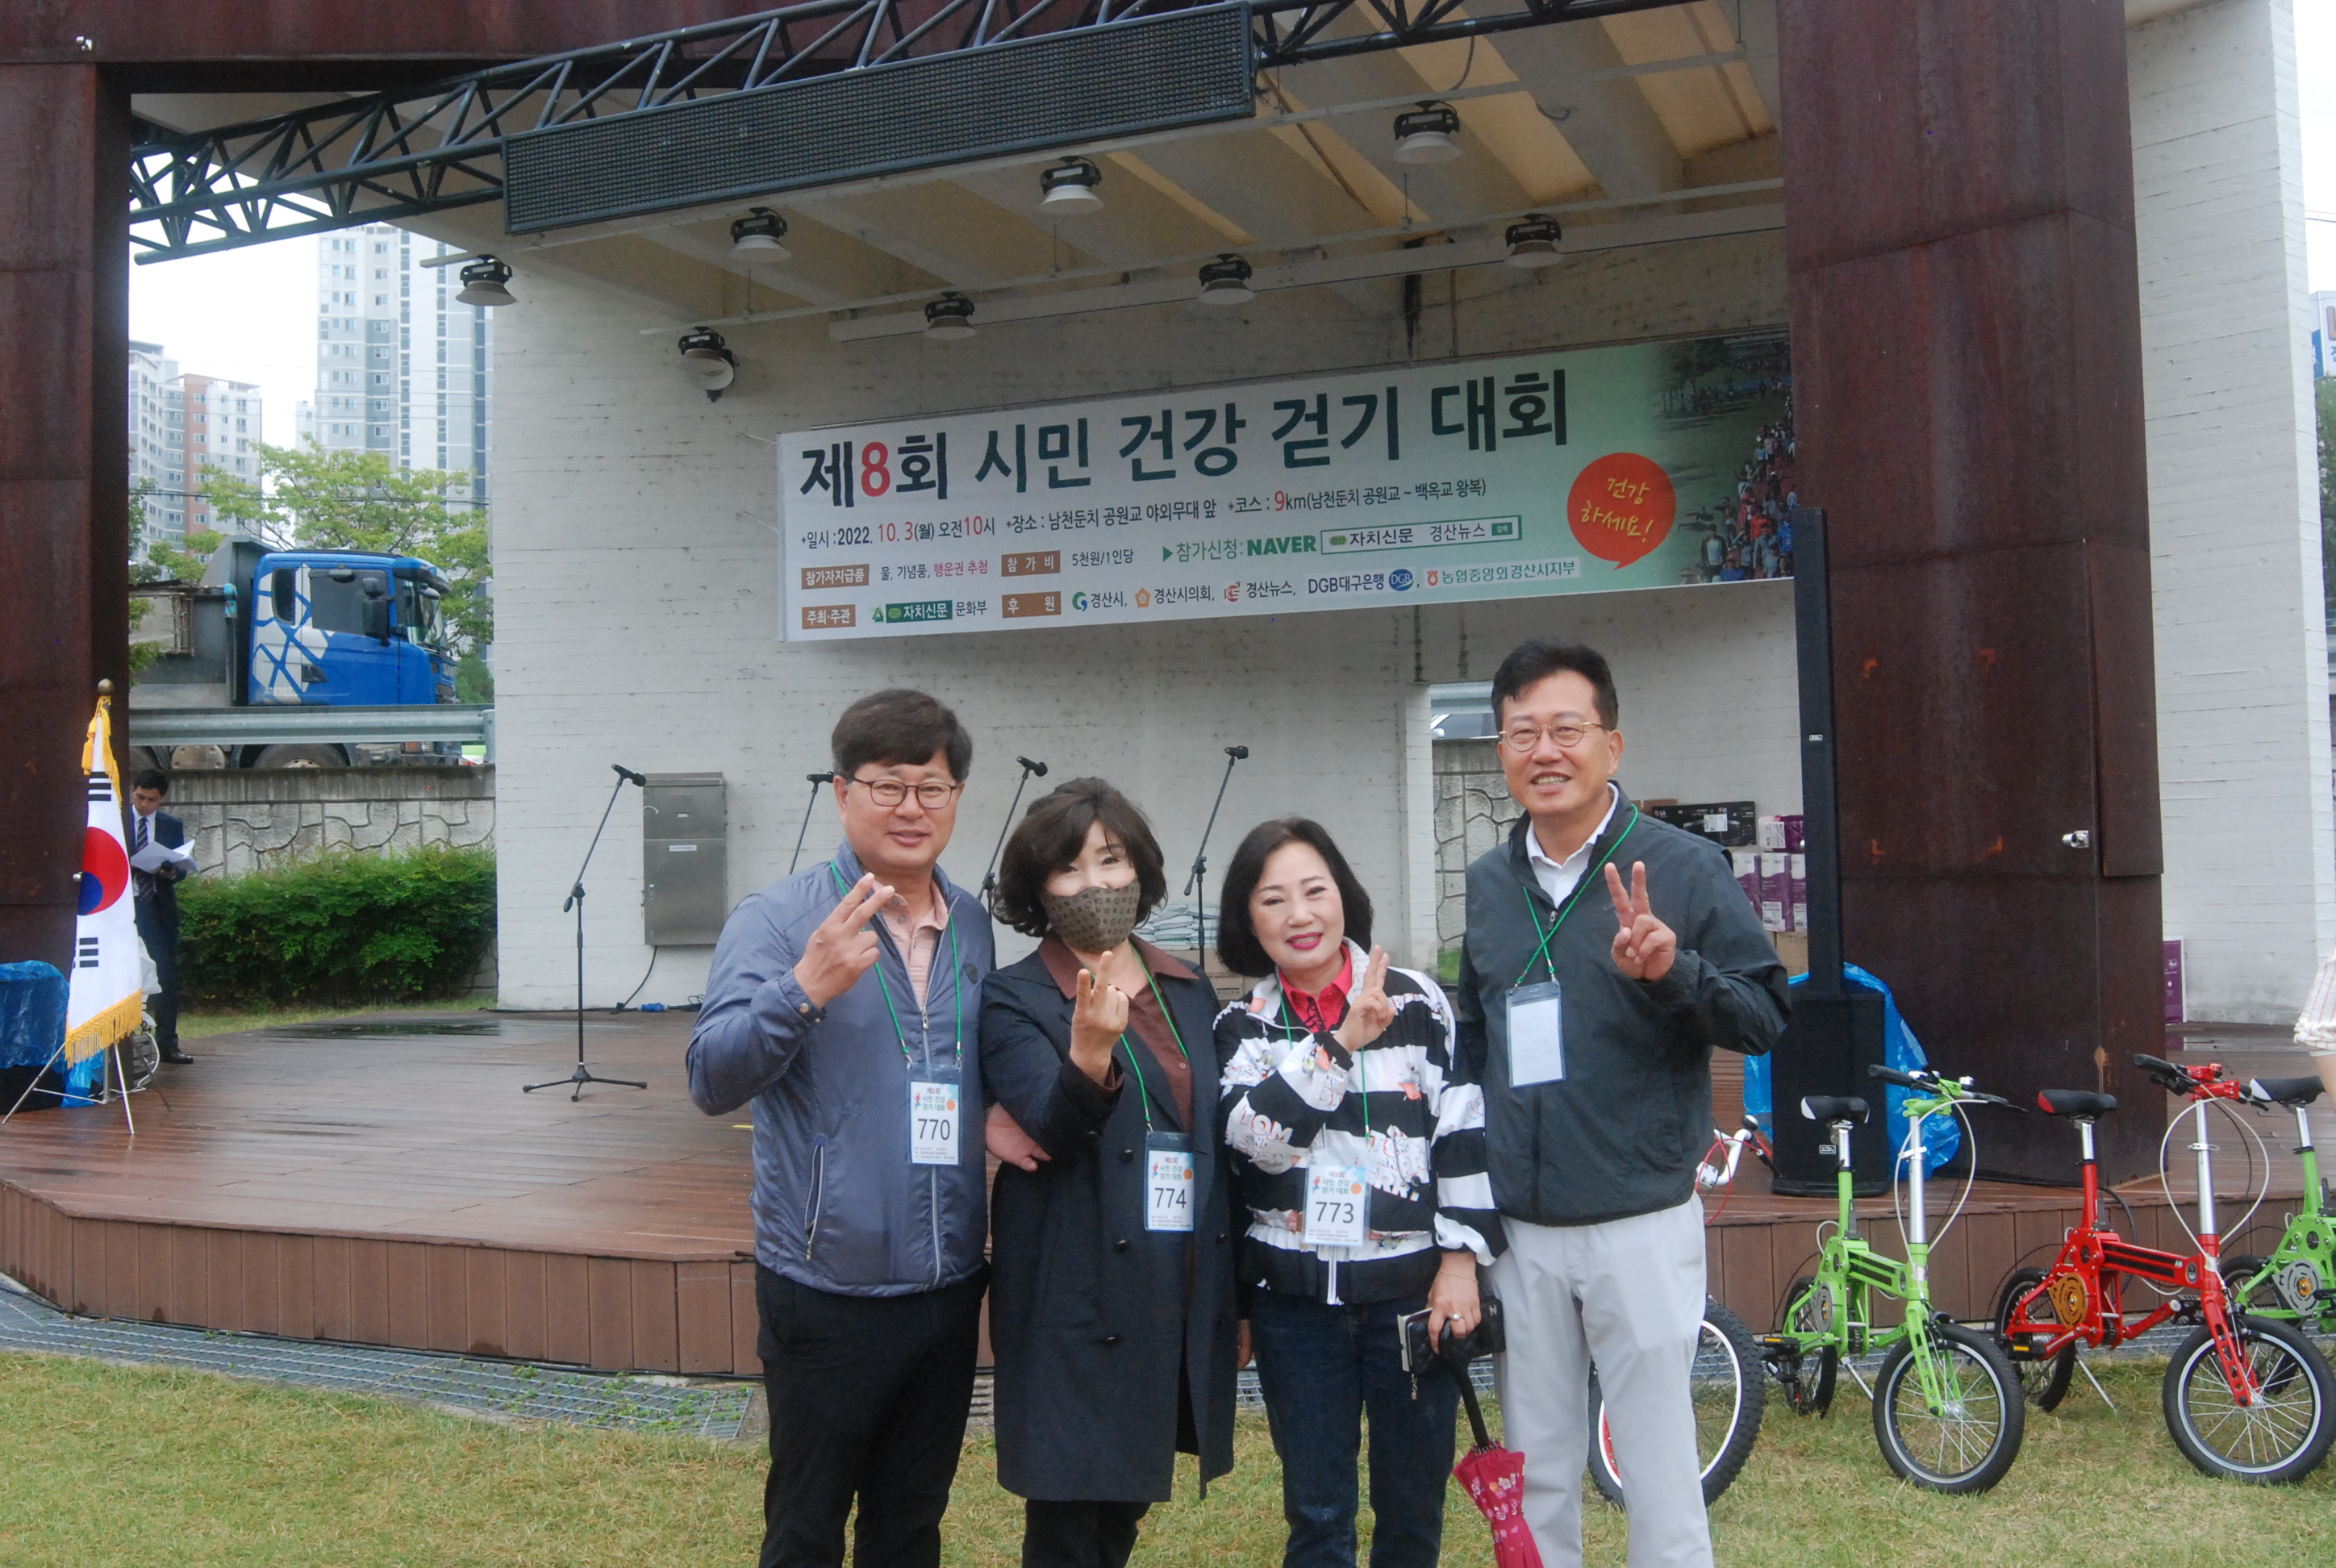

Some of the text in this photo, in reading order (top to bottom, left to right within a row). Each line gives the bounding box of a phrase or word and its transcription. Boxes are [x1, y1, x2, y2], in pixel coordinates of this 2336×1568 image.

[799, 369, 1567, 508] 제8회 시민 건강 걷기 대회
[1234, 496, 1262, 513] 코스
[1362, 486, 1400, 506] 공원교
[1415, 481, 1454, 502] 백옥교
[1455, 477, 1487, 498] 왕복)
[1608, 478, 1650, 505] 건강
[1049, 508, 1099, 531] 남천둔치
[1103, 505, 1141, 527] 공원교
[1146, 500, 1199, 523] 야외무대
[1203, 498, 1216, 519] 앞
[1581, 499, 1654, 543] 하세요!
[807, 531, 829, 549] 일시
[938, 515, 995, 539] 오전10시
[1349, 528, 1414, 547] 자치신문
[1429, 523, 1486, 542] 경산뉴스
[1072, 548, 1134, 566] 5천원/1인당
[1247, 535, 1317, 557] NAVER
[806, 569, 865, 586] 참가자지급품
[880, 560, 988, 581] 물, 기념품, 행운권 추첨
[1091, 591, 1128, 608] 경산시,
[1154, 585, 1215, 604] 경산시의회,
[1246, 581, 1296, 598] 경산뉴스,
[903, 601, 948, 619] 자치신문
[955, 600, 988, 617] 문화부
[918, 1118, 950, 1141] 770
[1155, 1187, 1187, 1208] 774
[1316, 1201, 1354, 1224] 773
